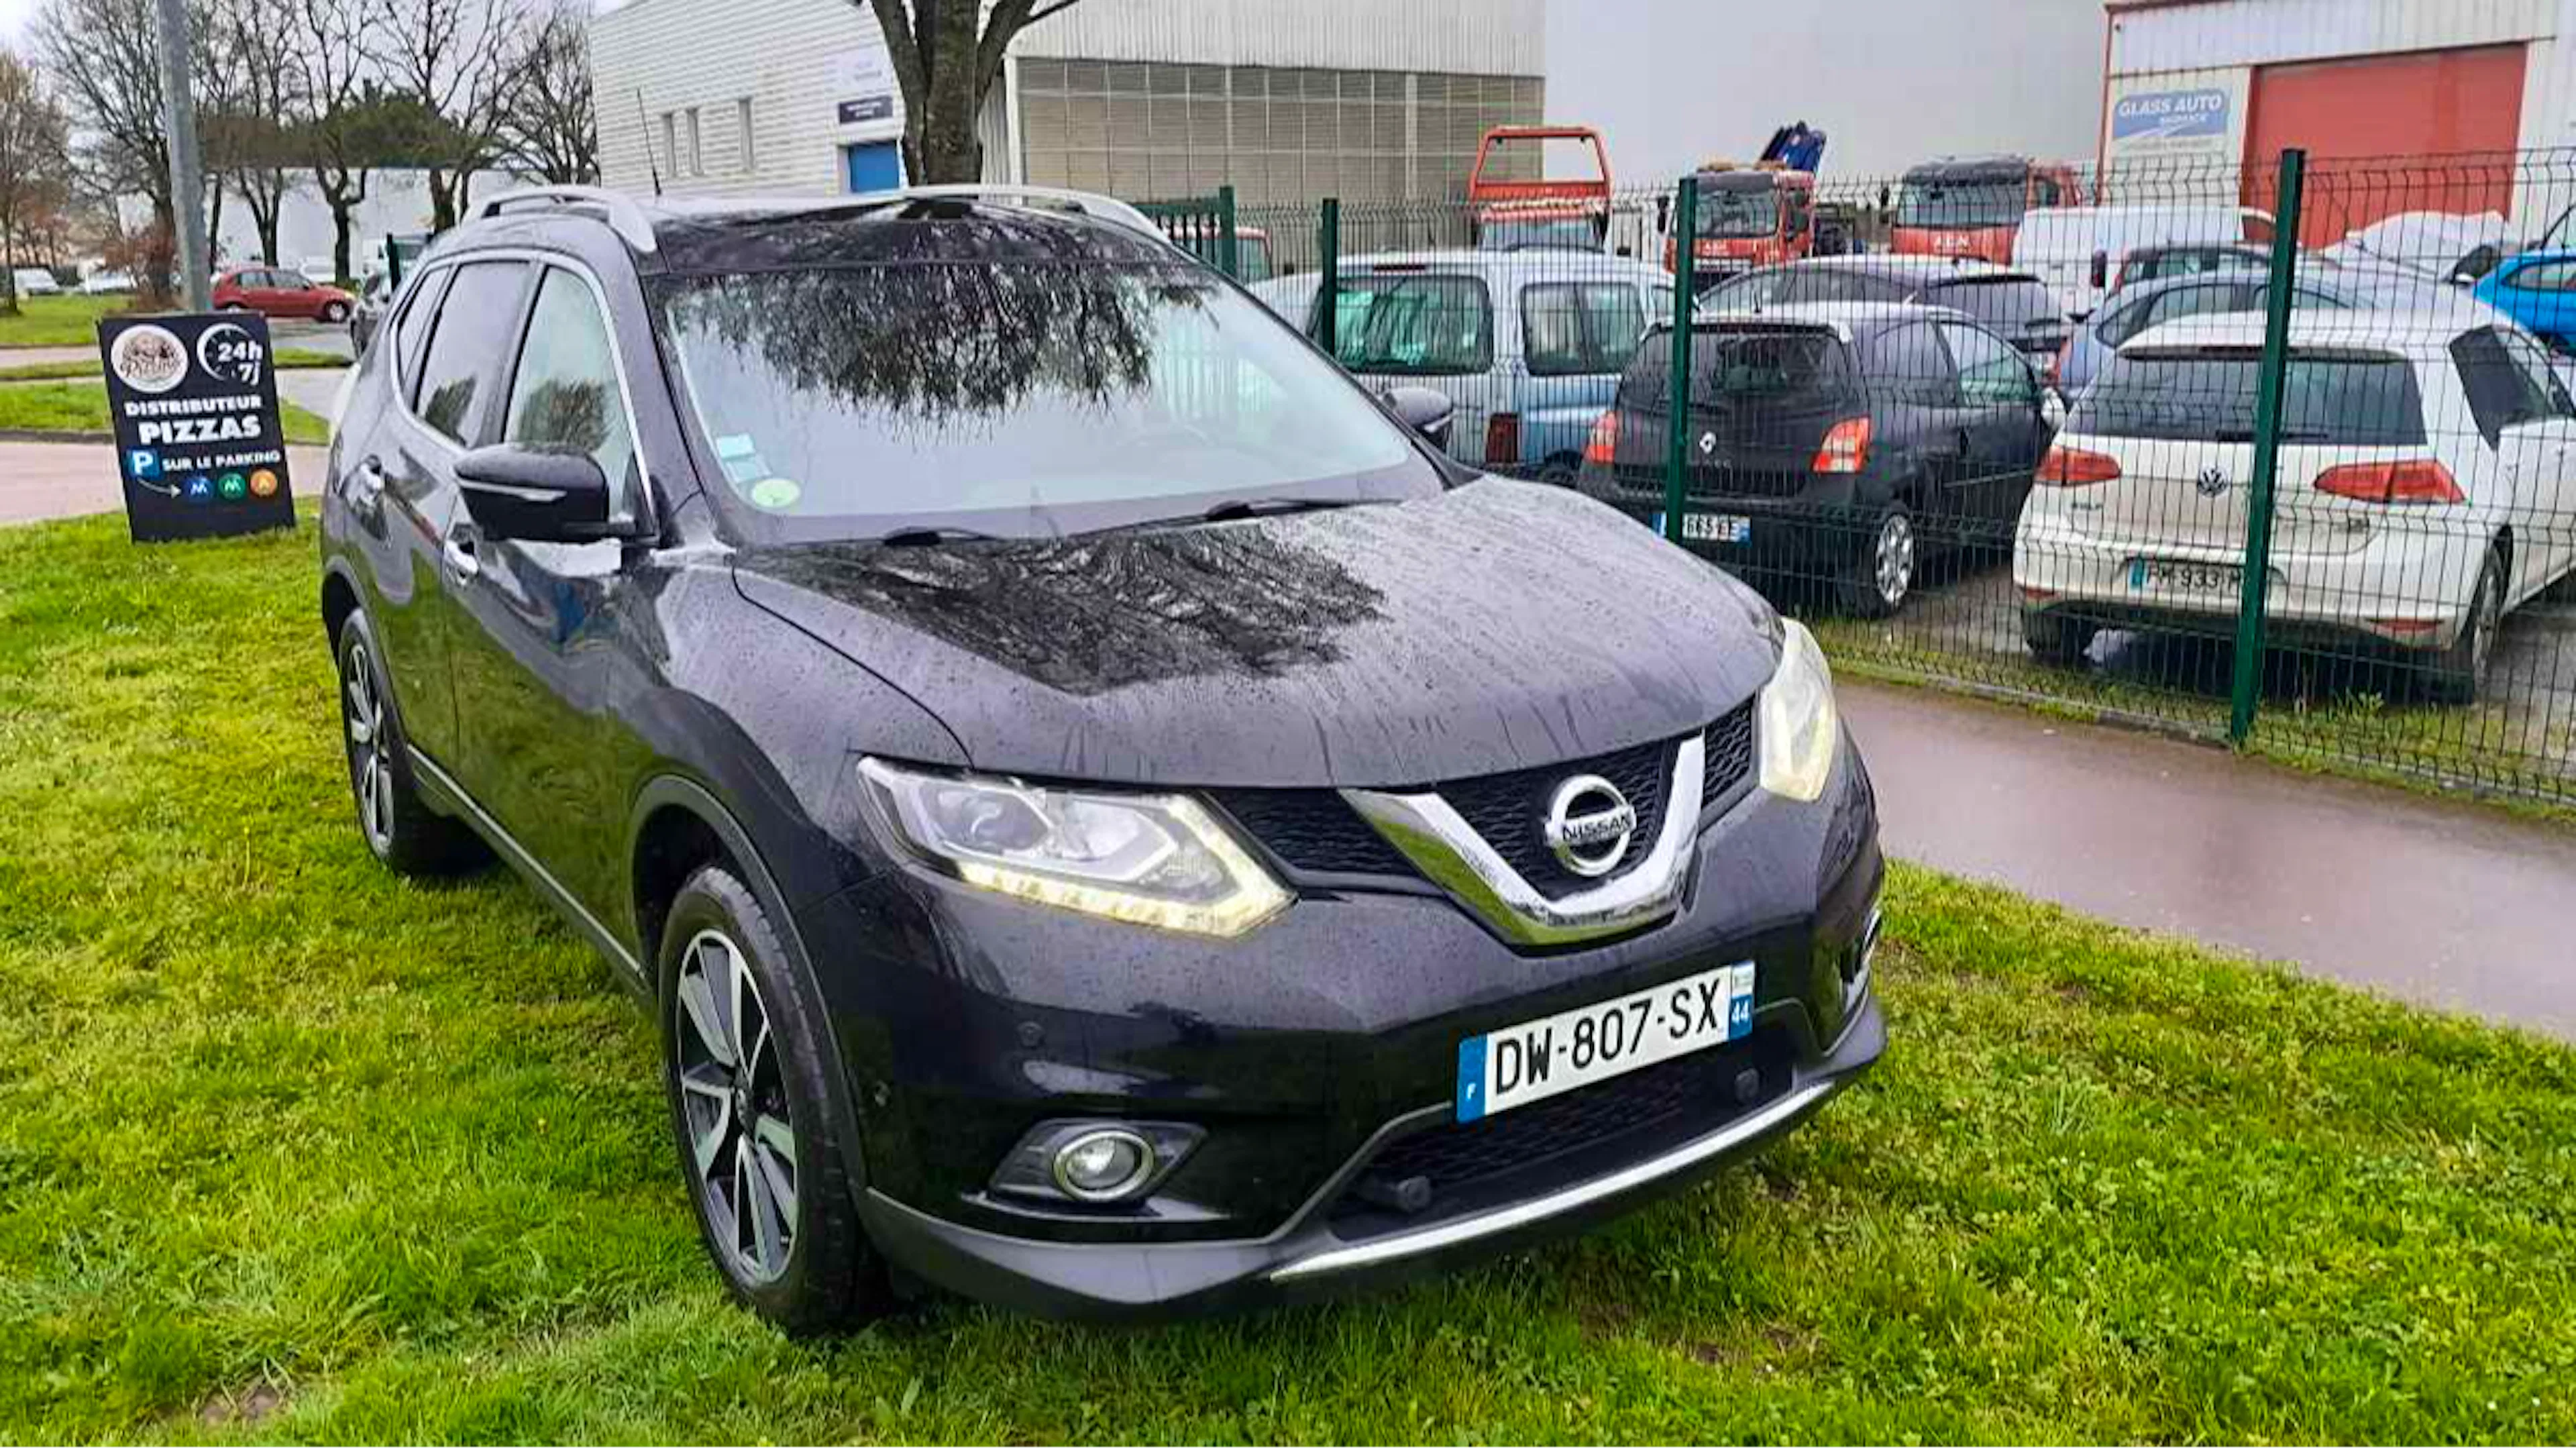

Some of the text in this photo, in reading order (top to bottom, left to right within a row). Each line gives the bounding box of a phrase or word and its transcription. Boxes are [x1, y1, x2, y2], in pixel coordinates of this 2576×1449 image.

[2118, 95, 2222, 117] GLASS AUTO
[217, 340, 263, 363] 24h
[238, 363, 260, 386] 7j
[123, 394, 262, 416] DISTRIBUTEUR
[138, 415, 262, 445] PIZZAS
[162, 457, 193, 472] SUR
[196, 455, 212, 469] LE
[215, 449, 280, 468] PARKING
[1562, 815, 1631, 841] NISSAN
[1495, 977, 1750, 1095] DW-807-SX 44
